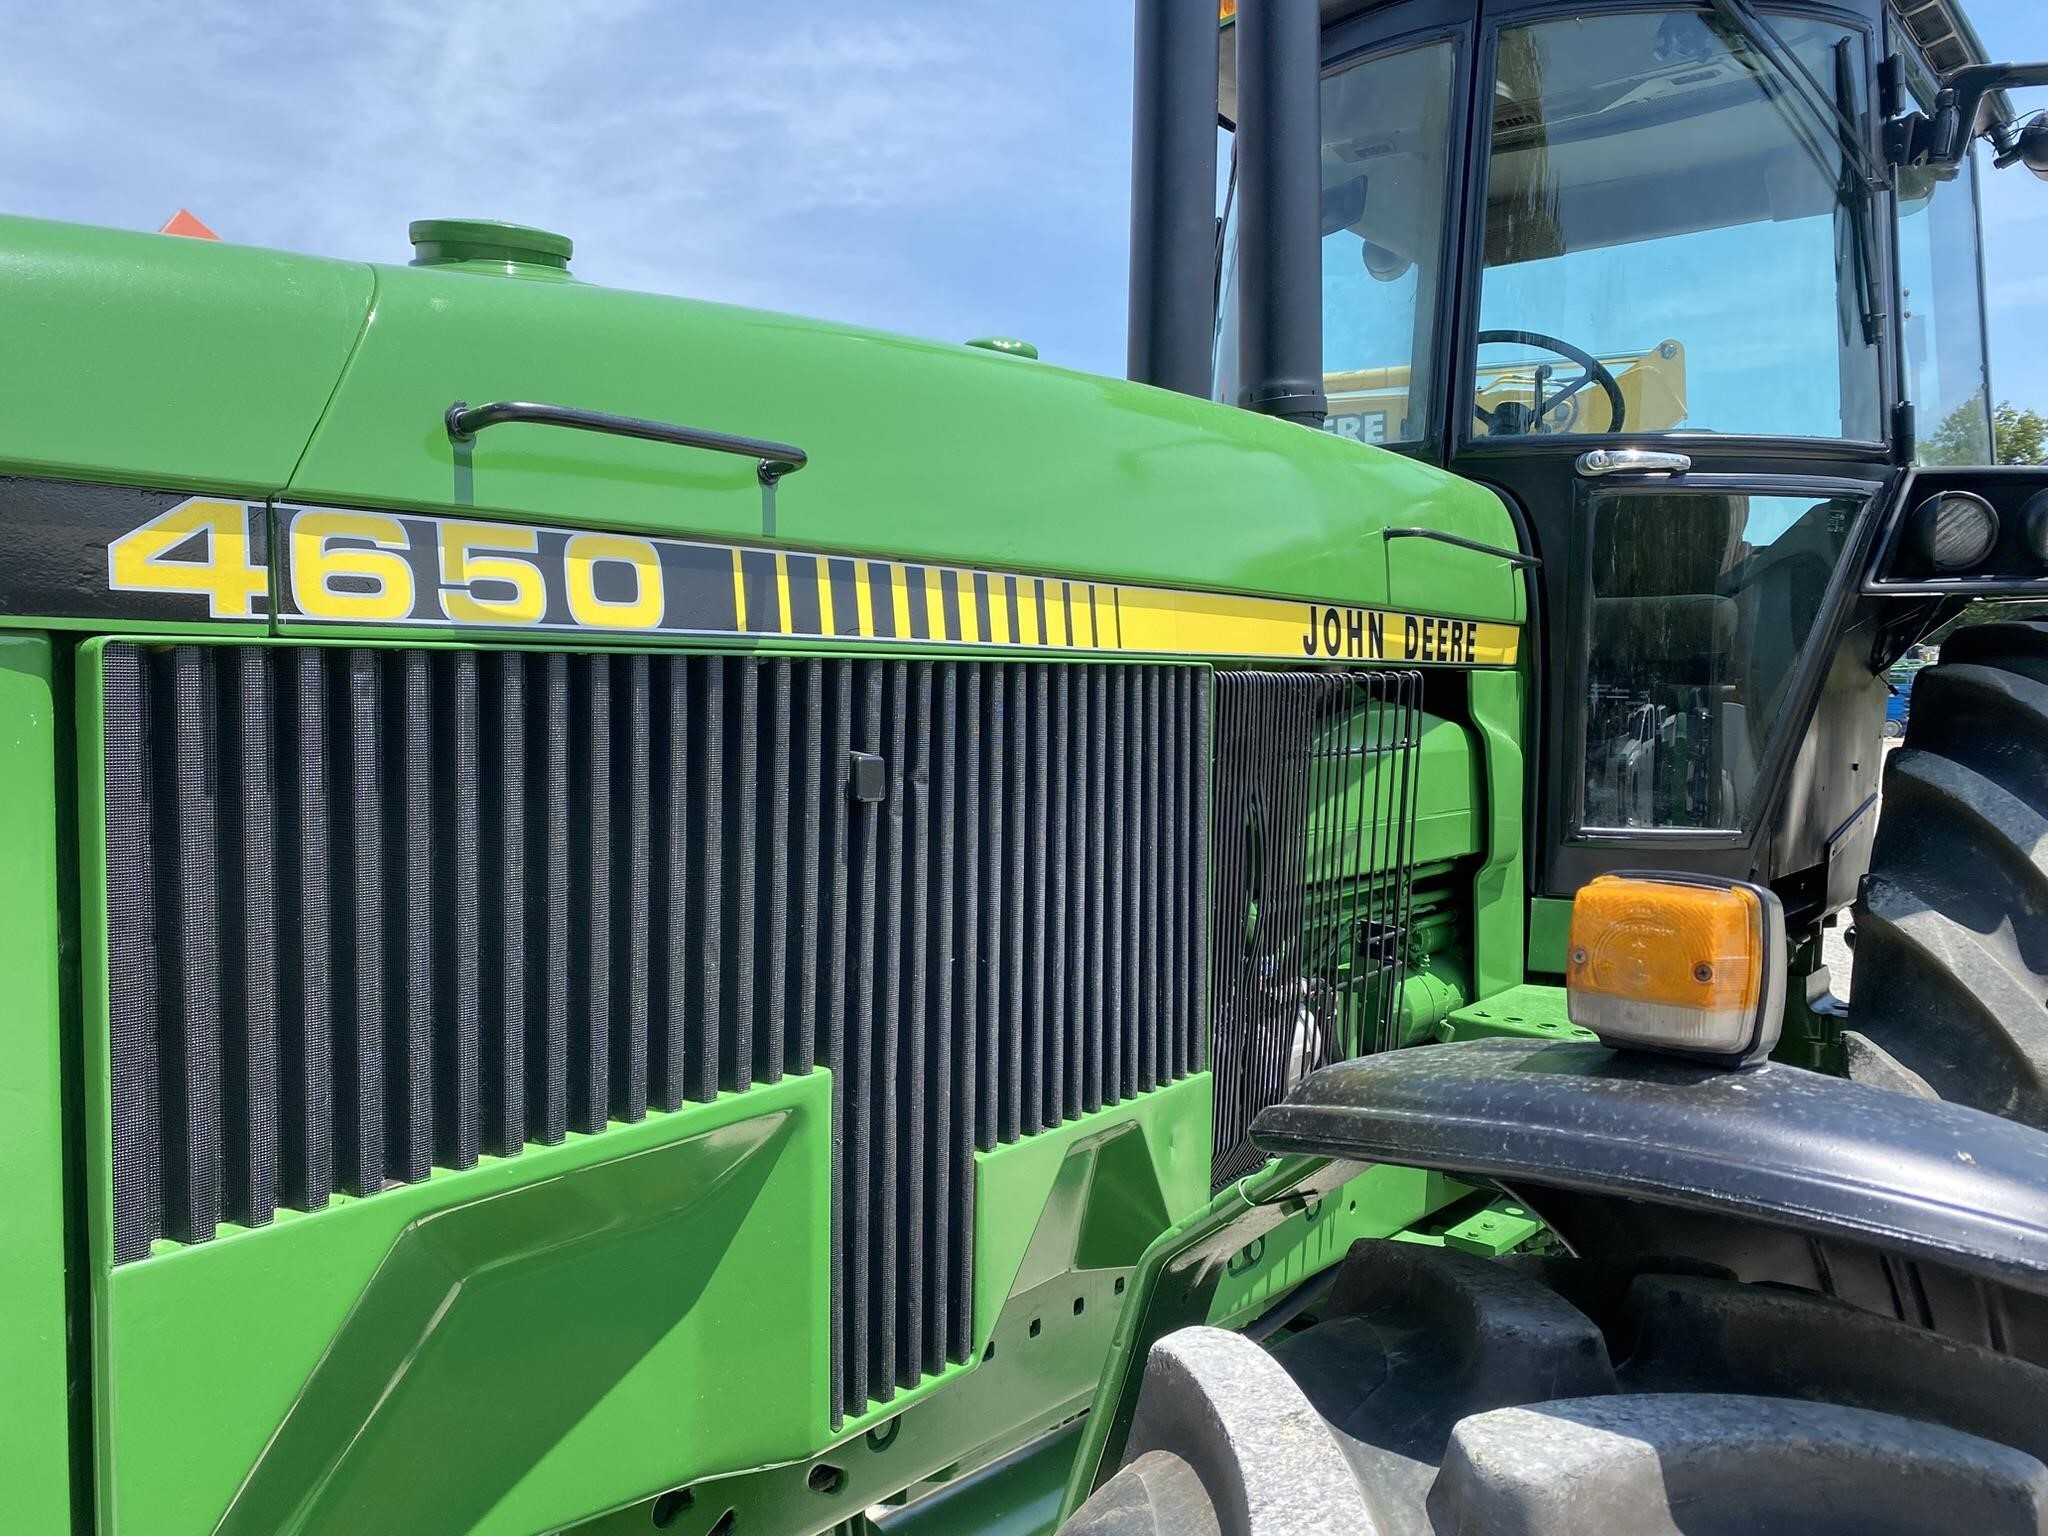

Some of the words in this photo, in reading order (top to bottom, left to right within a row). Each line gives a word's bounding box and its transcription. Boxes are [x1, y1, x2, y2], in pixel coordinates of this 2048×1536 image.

[107, 496, 665, 629] 4650
[1302, 605, 1384, 659] JOHN
[1404, 615, 1478, 663] DEERE
